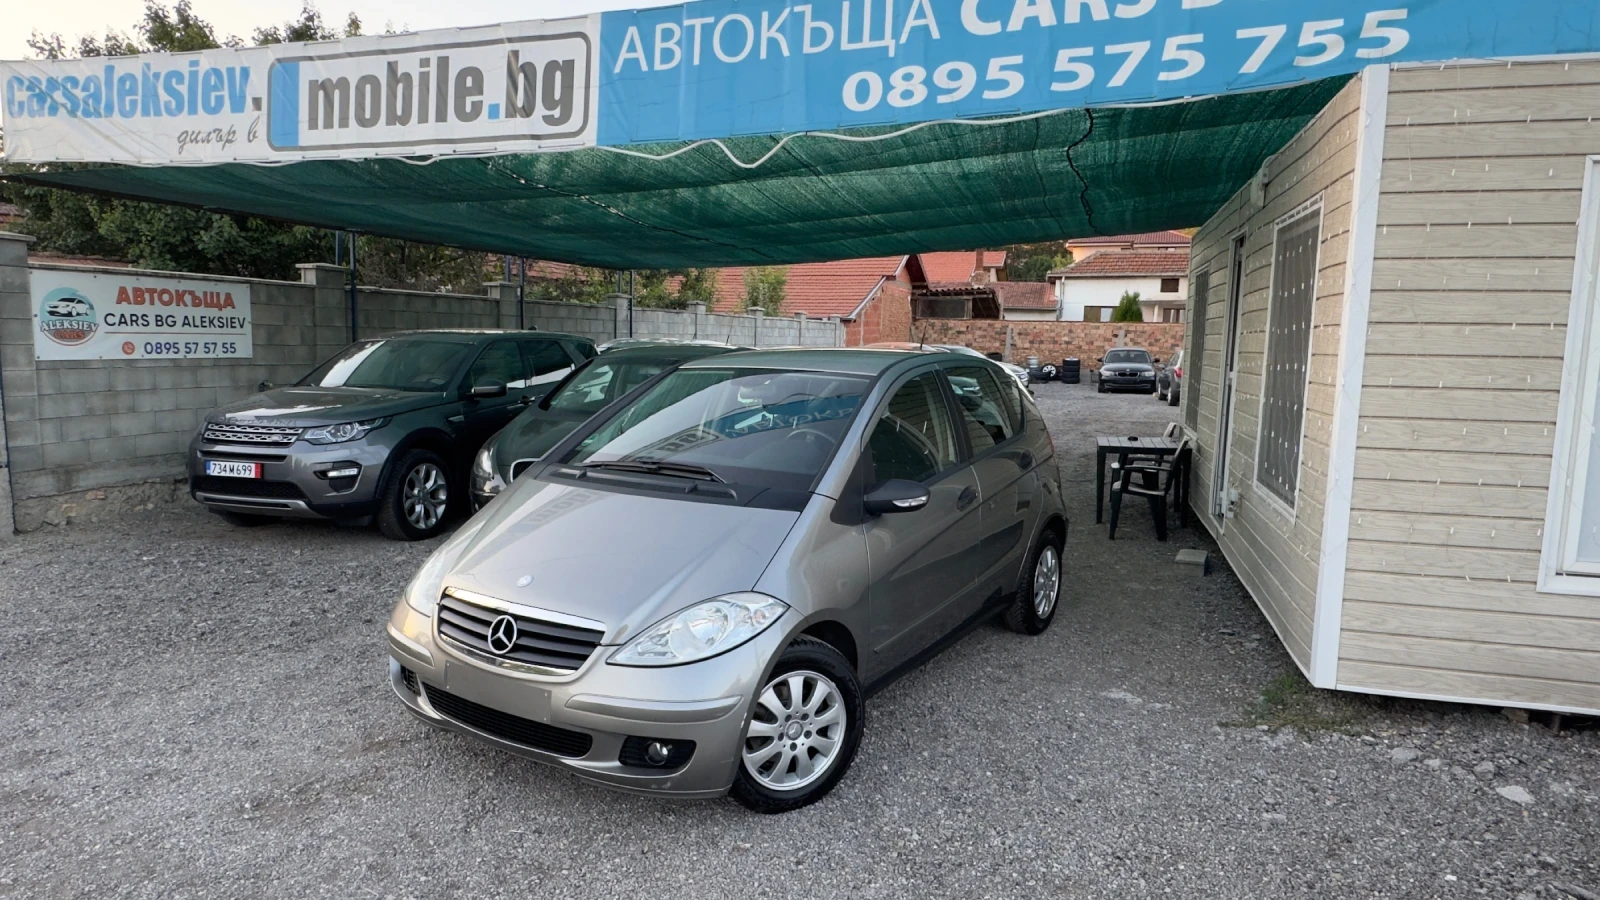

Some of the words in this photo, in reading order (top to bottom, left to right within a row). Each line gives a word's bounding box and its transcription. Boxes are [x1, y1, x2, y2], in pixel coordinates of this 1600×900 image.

[614, 0, 941, 74] АВТОКЪЩА
[842, 55, 1024, 112] 0895
[1050, 34, 1205, 91] 575
[1236, 9, 1411, 74] 755
[307, 49, 576, 131] mobile.bg
[115, 286, 236, 311] АВТОКЪЩА
[41, 320, 99, 332] ALEKSIEV
[104, 313, 150, 328] CARS
[155, 314, 177, 328] BG
[181, 315, 247, 329] ALEKSIEV
[54, 330, 86, 340] CARS
[144, 342, 180, 355] 0895
[184, 342, 199, 355] 57
[203, 342, 218, 355] 57
[222, 342, 237, 354] 55
